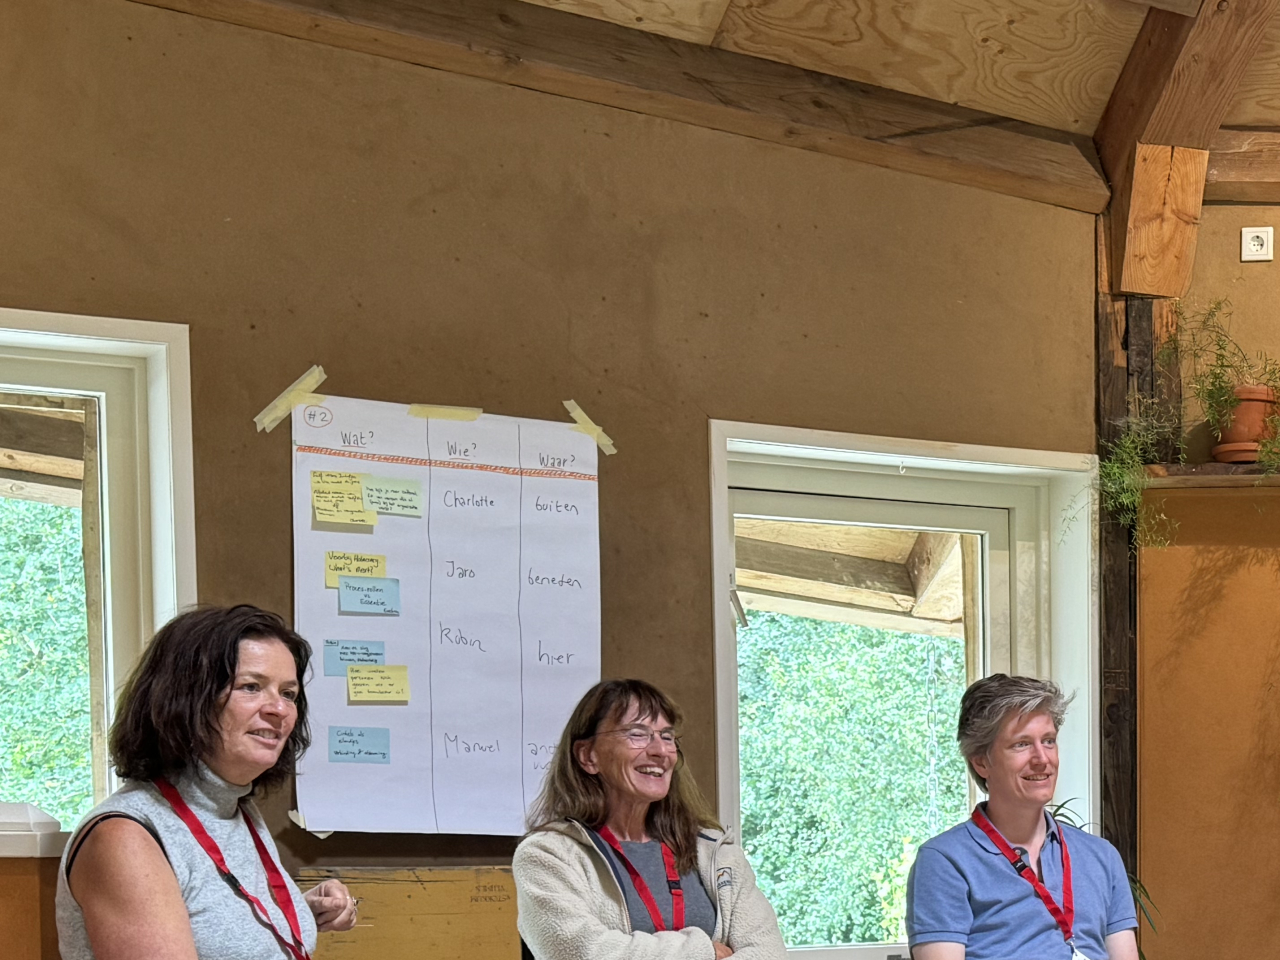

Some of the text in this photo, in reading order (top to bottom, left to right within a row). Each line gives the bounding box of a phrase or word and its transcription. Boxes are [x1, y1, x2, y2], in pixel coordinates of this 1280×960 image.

[341, 431, 576, 468] Wat? Wie? Waar?
[443, 490, 495, 509] Charlotte
[446, 560, 476, 579] Jaro
[440, 621, 575, 665] Robin hier
[444, 733, 500, 758] Manuel
